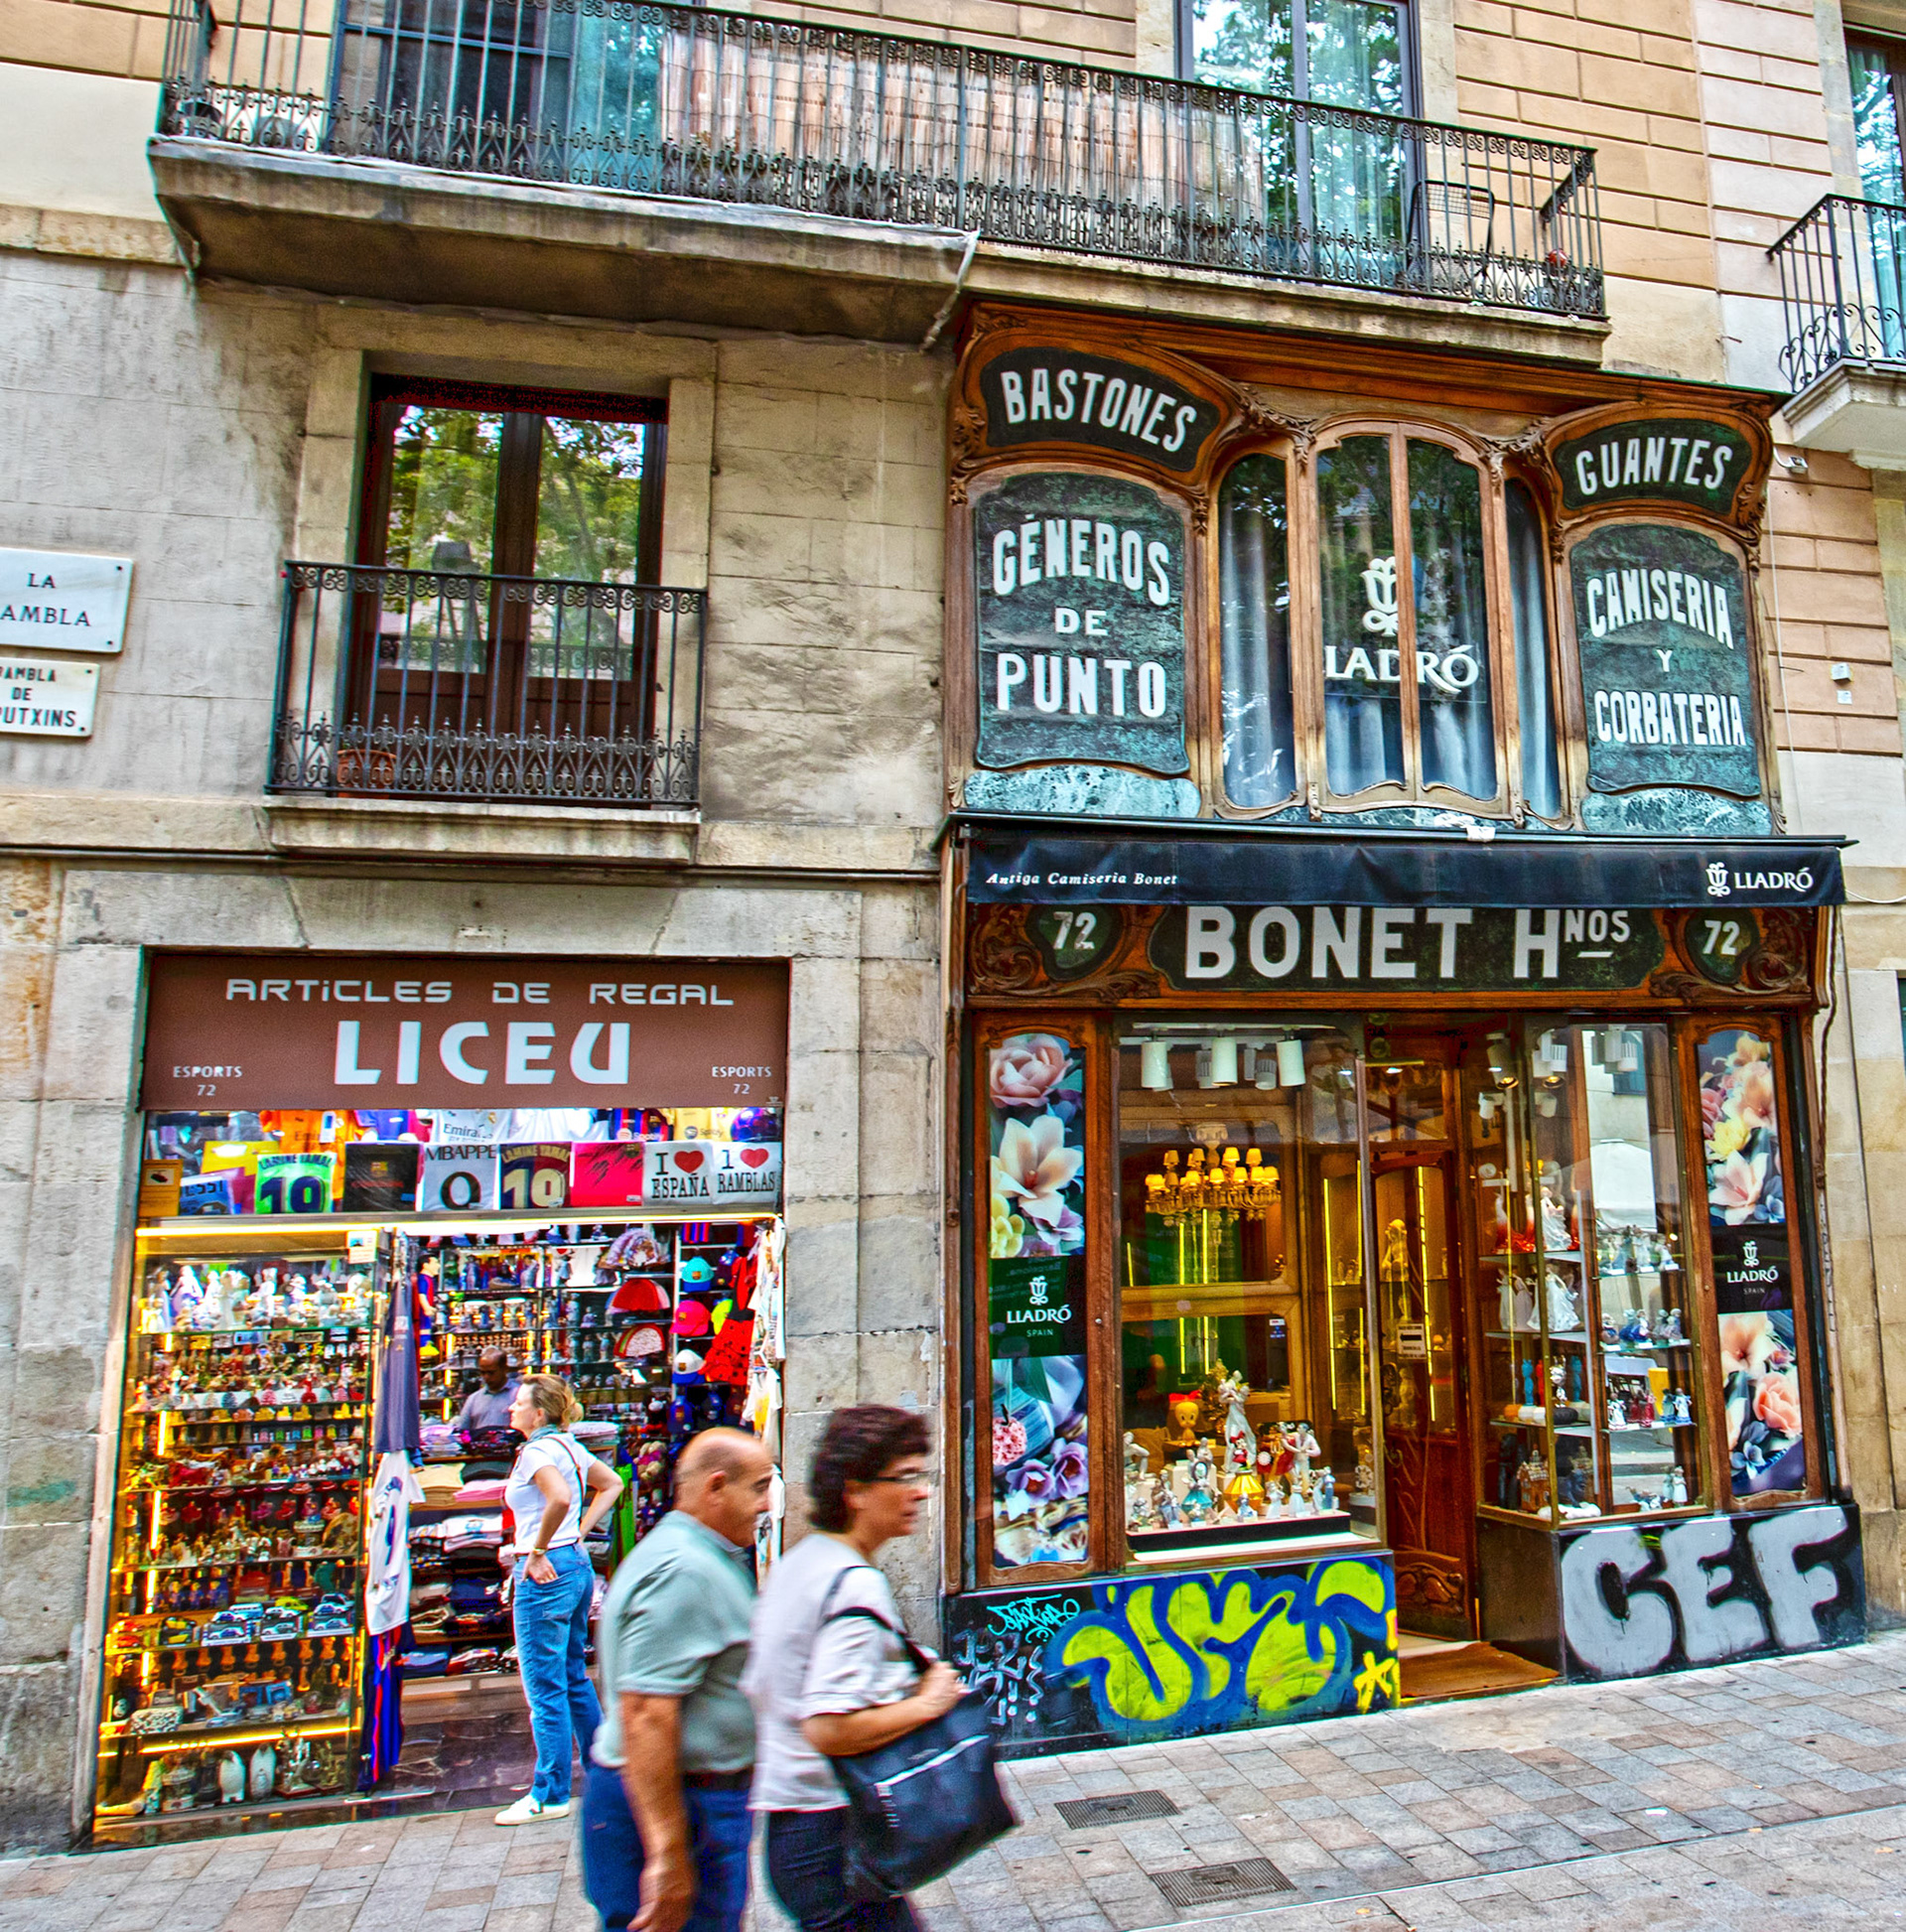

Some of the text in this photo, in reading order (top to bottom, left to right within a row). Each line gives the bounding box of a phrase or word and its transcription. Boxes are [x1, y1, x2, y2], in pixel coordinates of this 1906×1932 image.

[1001, 367, 1196, 454] BASTONES
[1575, 437, 1732, 494] GUANTES
[993, 513, 1169, 607] GÉNEROS
[27, 573, 57, 589] LA
[0, 604, 91, 626] AMBLA
[1587, 569, 1734, 649] CAMISERIA
[1054, 608, 1109, 636] DE
[1322, 644, 1479, 694] LADRÓ
[1657, 649, 1674, 672] Y
[11, 687, 33, 701] DE
[997, 652, 1166, 718] PUNTO
[0, 707, 76, 728] UTXINS
[1594, 690, 1747, 747] CORBATERIA
[986, 872, 1177, 886] Antiga Camiseria Bonet
[1734, 867, 1814, 892] LLADRÓ
[1053, 911, 1097, 949] 72
[1185, 905, 1473, 978] BONET
[1702, 920, 1739, 955] 72
[492, 982, 550, 1004] DE
[589, 984, 734, 1006] REGAL
[335, 1021, 630, 1084] LICEU
[173, 1066, 243, 1078] ESPORTS
[712, 1066, 771, 1078] ESPORTS
[197, 1084, 216, 1096] 72
[733, 1083, 750, 1095] 72
[655, 1153, 669, 1174] I
[259, 1175, 326, 1213] 10
[503, 1168, 566, 1208] 10
[651, 1173, 710, 1198] ESPAÑA
[718, 1172, 775, 1193] RAMBLAS
[1727, 1266, 1779, 1284] LLADRÓ
[1007, 1304, 1072, 1324] LLADRÓ
[1026, 1328, 1053, 1337] SPAIN
